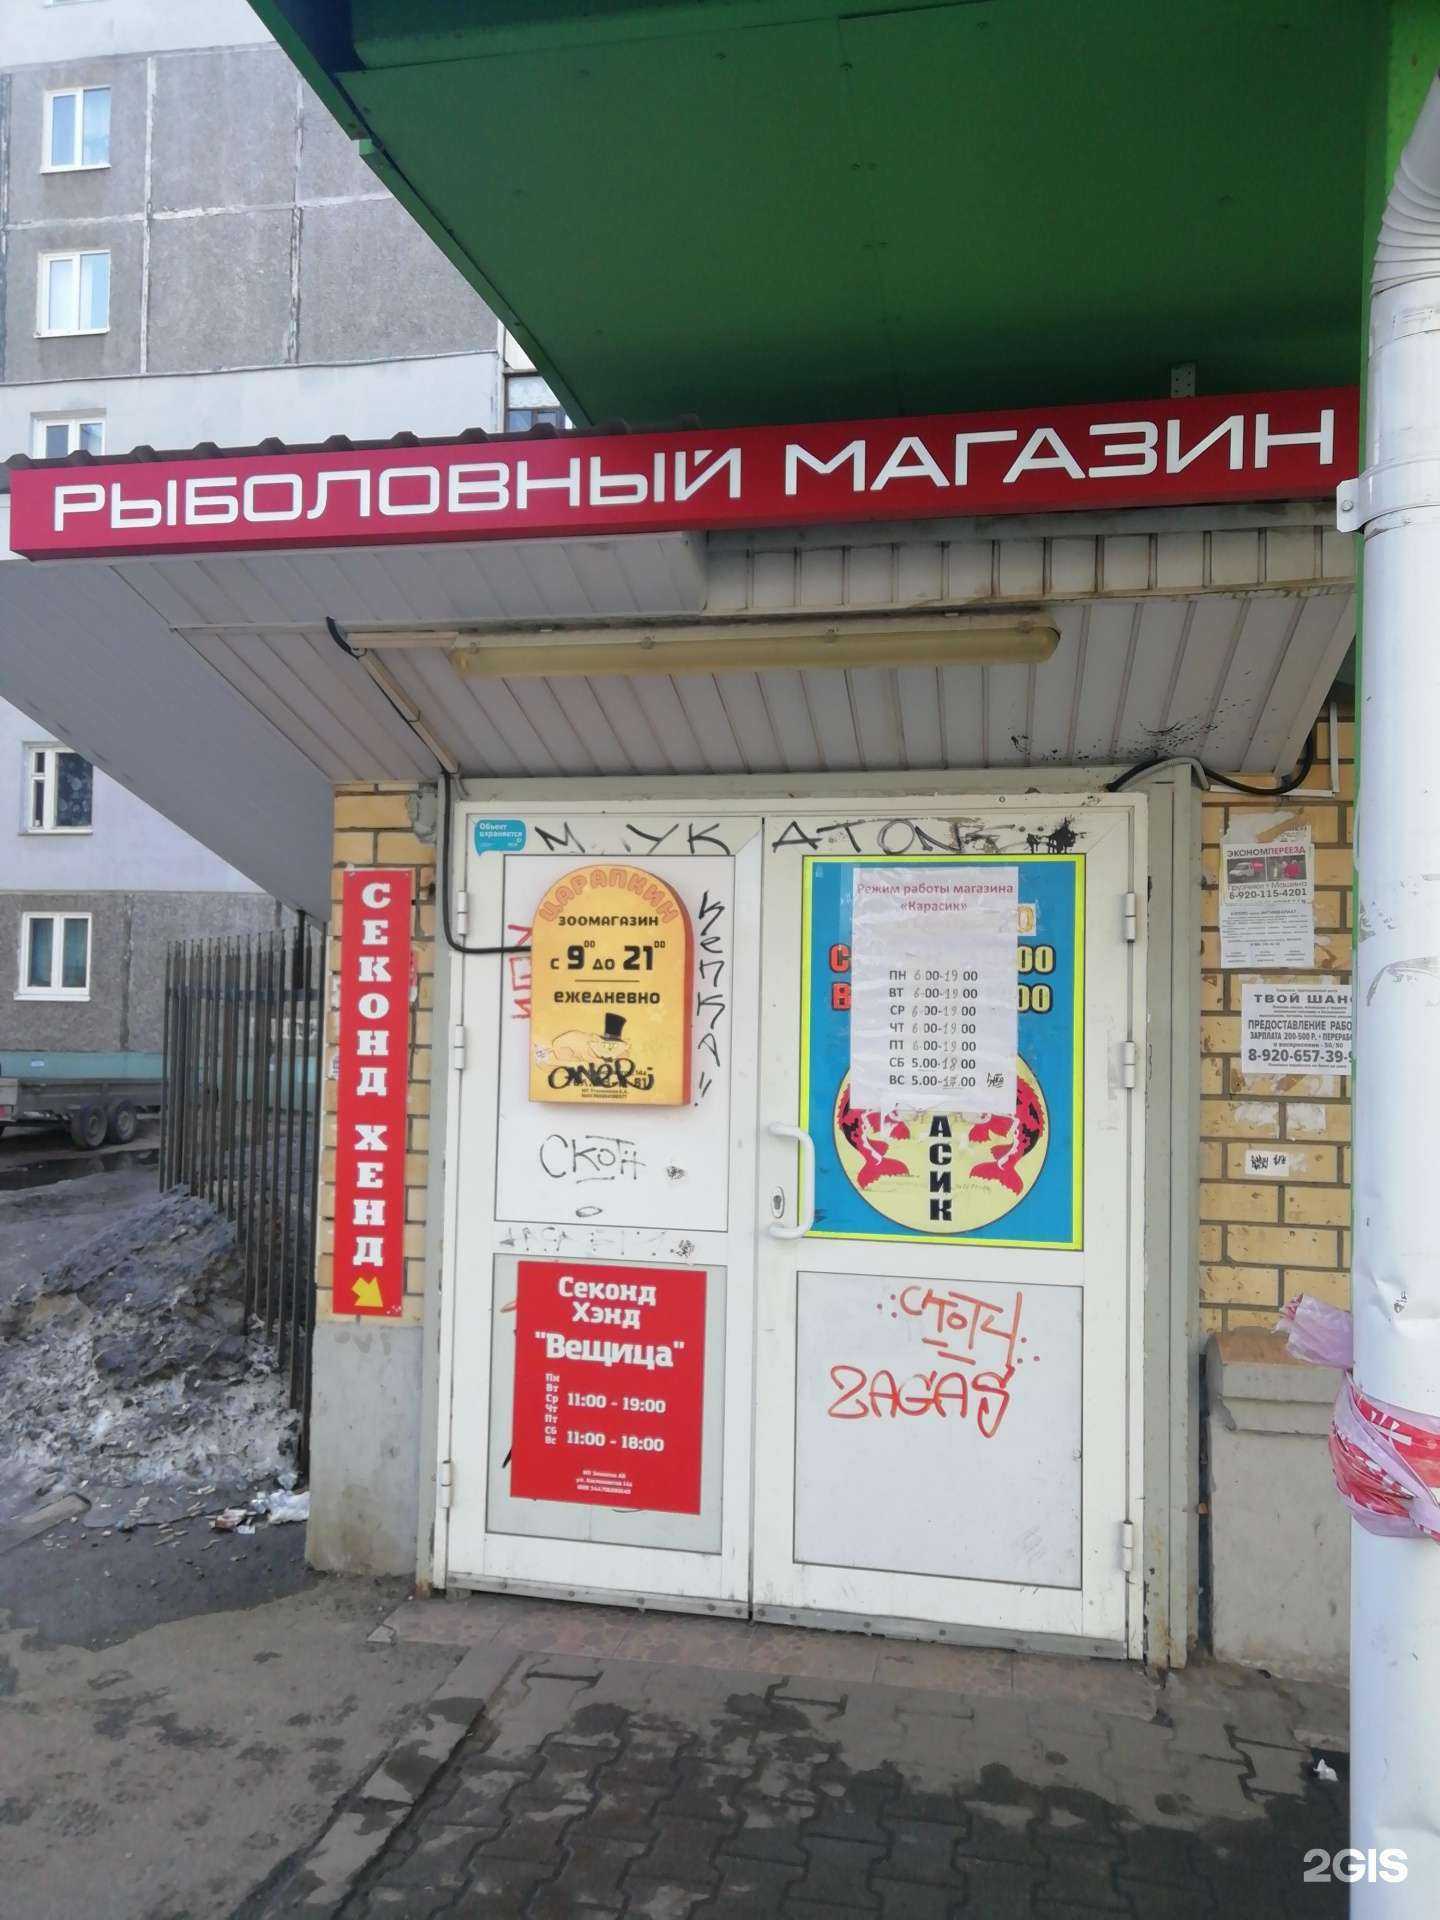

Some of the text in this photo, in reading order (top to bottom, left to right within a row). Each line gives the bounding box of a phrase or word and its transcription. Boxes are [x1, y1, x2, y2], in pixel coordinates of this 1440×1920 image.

[54, 409, 1335, 531] РЫБОЛОВНЫЙ МАГАЗИН
[538, 868, 679, 923] ЦАРАПКИН
[857, 882, 1014, 897] Режим работы магазина
[889, 970, 906, 981] ПН
[356, 882, 392, 1096] СЕКОНД
[889, 987, 904, 998] ВТ
[1254, 992, 1353, 1005] ТВОЙ ШАН
[890, 1005, 905, 1015] СР
[889, 1022, 904, 1033] ЧТ
[1248, 1020, 1327, 1031] ПРЕДОСТАВЛЕНИЕ
[1250, 1032, 1282, 1040] ЗАРПЛАТА
[889, 1039, 904, 1050] ПТ
[889, 1057, 905, 1068] СБ
[889, 1075, 905, 1085] ВС
[352, 1124, 388, 1267] ХЕНД
[558, 1276, 657, 1306] Секонд
[572, 1301, 641, 1329] Хэнд
[534, 1331, 685, 1370] "Вещица"
[567, 1392, 607, 1408] 11:00
[622, 1396, 666, 1414] 19:00
[566, 1430, 606, 1446] 11:00
[621, 1434, 665, 1452] 18:00
